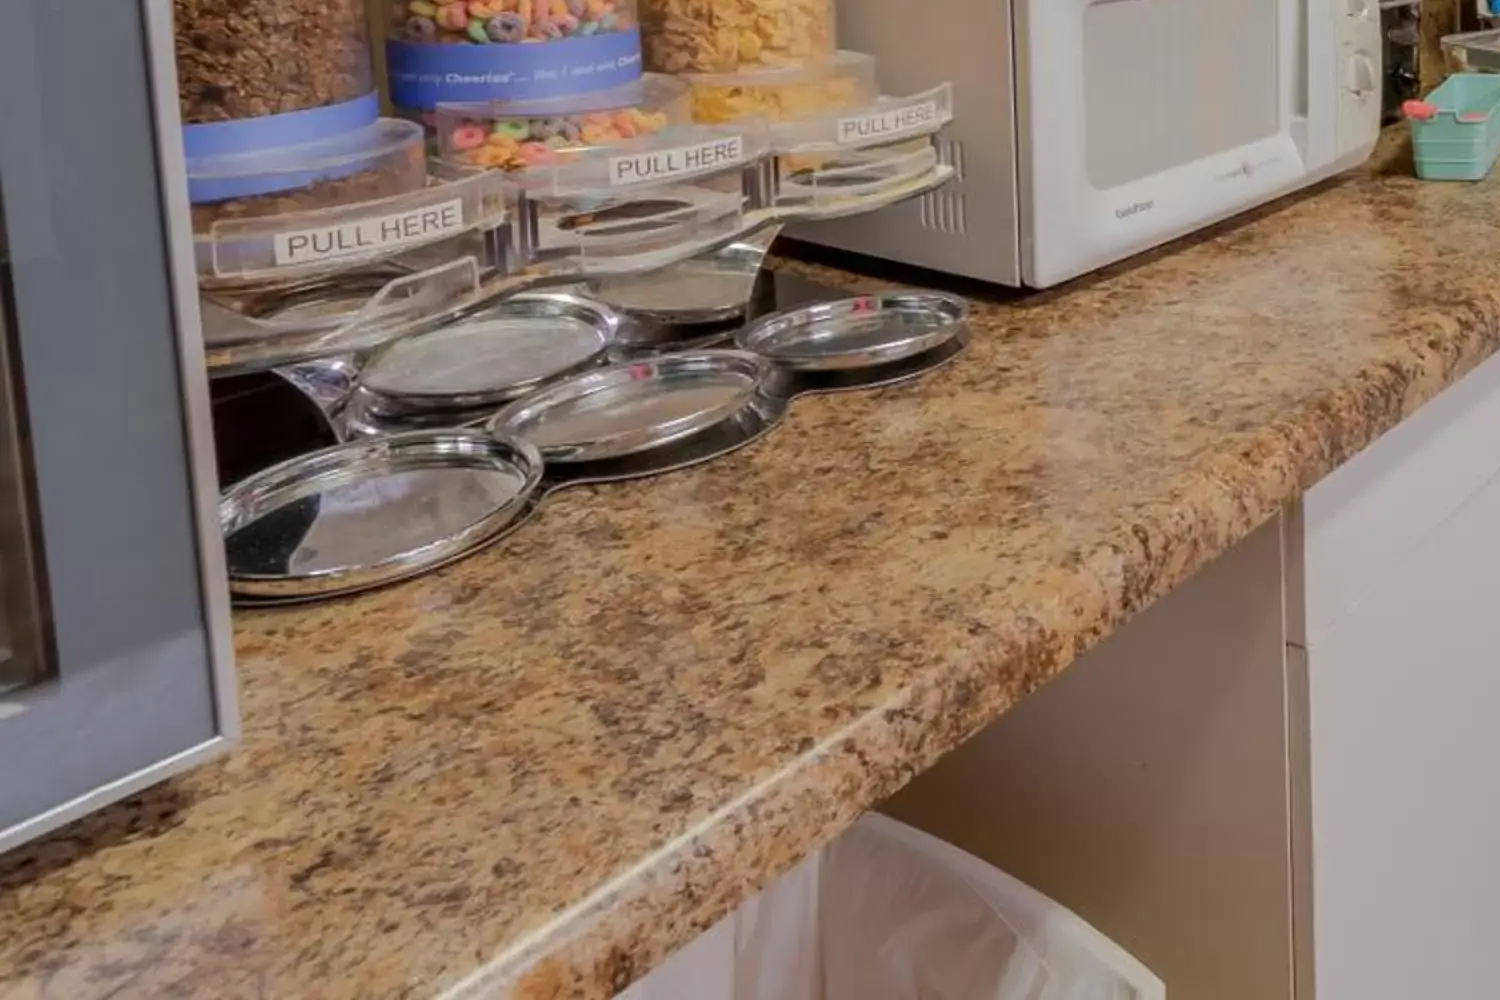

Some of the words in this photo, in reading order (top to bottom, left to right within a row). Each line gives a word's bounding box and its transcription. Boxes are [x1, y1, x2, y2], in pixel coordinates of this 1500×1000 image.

[841, 117, 889, 138] PULL
[894, 103, 933, 129] HERE
[616, 154, 680, 179] PULL
[685, 140, 738, 169] HERE
[287, 225, 374, 257] PULL
[380, 204, 458, 242] HERE
